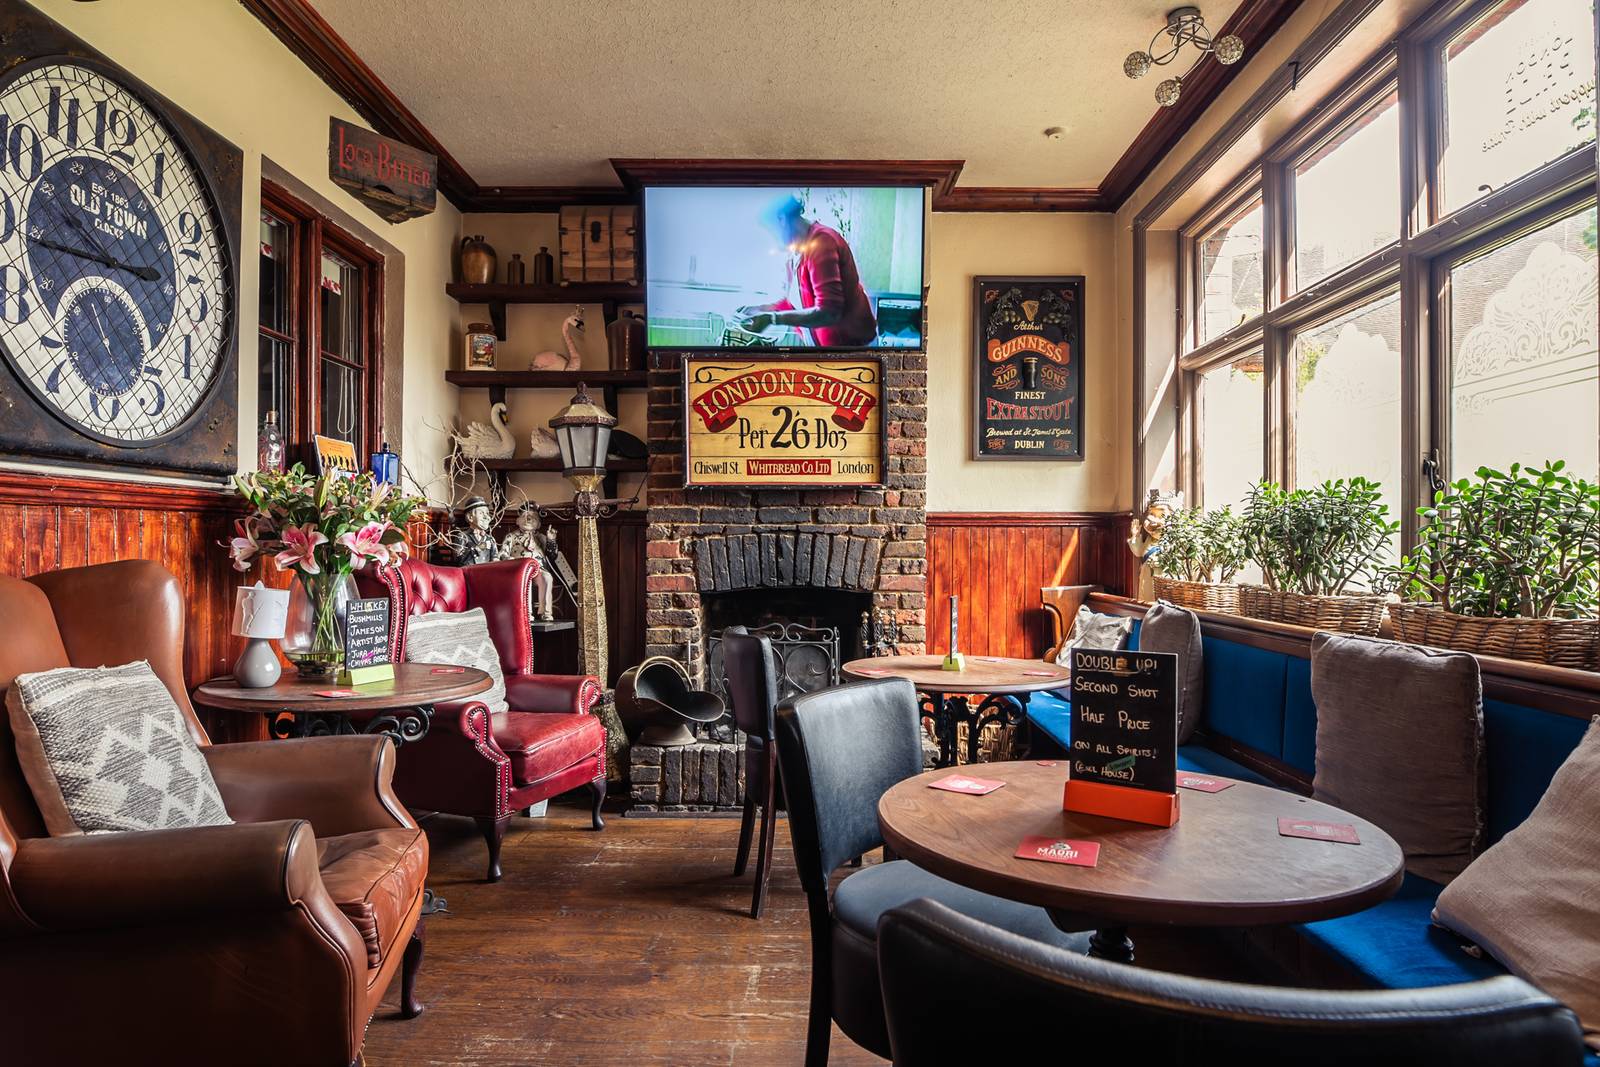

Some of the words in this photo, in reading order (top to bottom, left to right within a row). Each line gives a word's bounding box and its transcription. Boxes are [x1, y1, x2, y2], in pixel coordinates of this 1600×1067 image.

[43, 86, 81, 153] 11
[91, 100, 137, 167] 12
[69, 183, 100, 215] OLD
[105, 201, 148, 240] TOWN
[94, 218, 124, 240] CLOCKS
[1013, 320, 1043, 331] Arthur
[992, 335, 1063, 363] GUINNESS
[995, 367, 1017, 386] AND
[1040, 366, 1067, 386] SONS
[697, 372, 795, 419] LONDON
[801, 374, 871, 416] STOUT
[1015, 391, 1046, 400] FINEST
[986, 397, 1029, 420] EXTRA
[1029, 397, 1074, 420] STOUT
[739, 417, 768, 449] Per
[986, 427, 1013, 438] Brewed
[1013, 428, 1022, 436] at
[1014, 440, 1045, 449] DUBLIN
[694, 461, 728, 475] Chiswell
[749, 461, 800, 474] WHITBREAD
[837, 461, 874, 474] London
[350, 600, 388, 612] WHISKEY
[349, 614, 383, 623] BUSHMILLS
[351, 625, 385, 636] JAMESON
[1075, 652, 1122, 671] DOUBLE
[1074, 676, 1118, 694] SECOND
[1127, 684, 1158, 698] SHOT
[1080, 705, 1105, 724] HALF
[1117, 711, 1150, 730] PRICE
[1074, 740, 1091, 750] ON
[1096, 744, 1112, 754] ALL
